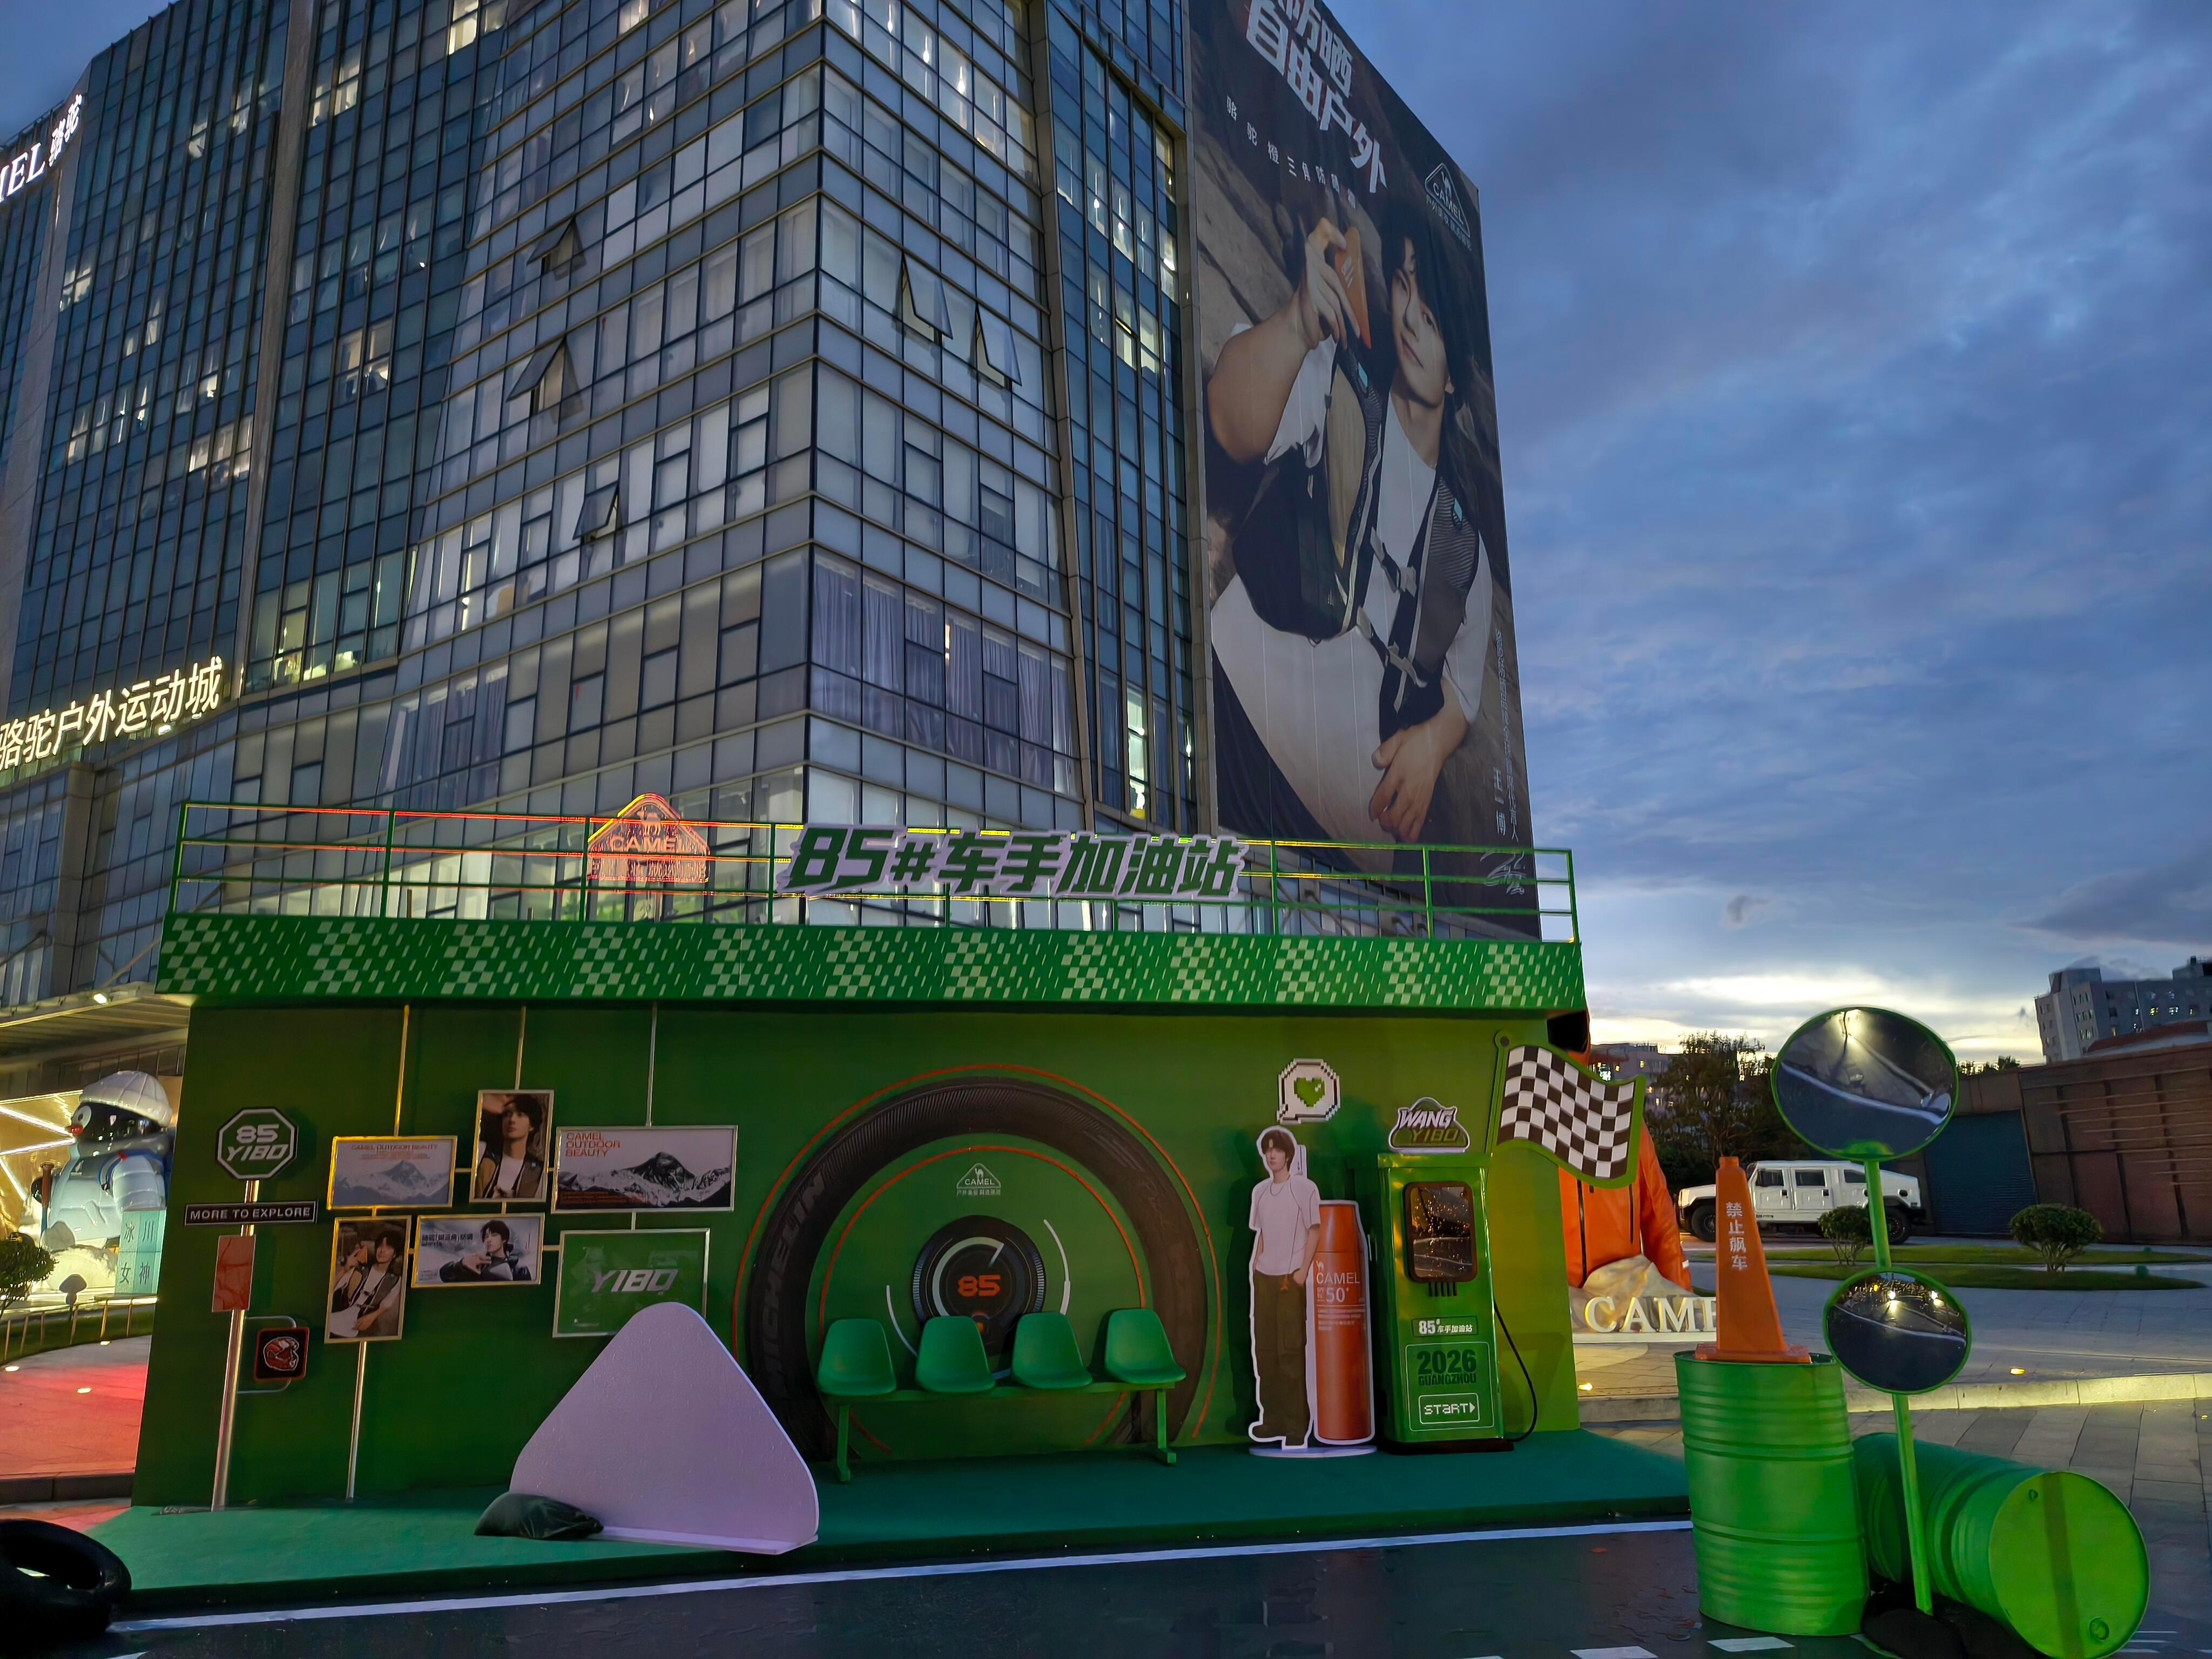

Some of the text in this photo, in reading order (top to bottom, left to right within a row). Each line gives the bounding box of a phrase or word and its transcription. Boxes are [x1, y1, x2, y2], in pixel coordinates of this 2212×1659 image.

[1246, 0, 1387, 193] 自由户外
[1433, 183, 1464, 225] CAMEL
[0, 656, 222, 771] 骆驼户外运动城
[610, 835, 686, 852] CAMEL
[786, 828, 1240, 896] 85#车手加油站
[1399, 1109, 1455, 1129] WANG
[236, 1124, 279, 1143] 85
[567, 1132, 602, 1140] CAMEL
[1412, 1129, 1459, 1142] YIBO
[227, 1144, 289, 1161] YIBO
[565, 1149, 609, 1157] BEAUTY
[566, 1140, 621, 1149] OUTDOOR
[190, 1208, 311, 1220] MORE TO EXPLORE
[124, 1221, 154, 1243] 冰川
[1726, 1202, 1748, 1271] 禁止飙车
[120, 1262, 150, 1284] 女神
[591, 1270, 679, 1292] YIBO
[1317, 1272, 1360, 1284] CAMEL
[958, 1275, 1001, 1297] 85
[1417, 1350, 1477, 1375] 2026
[1419, 1374, 1476, 1386] GUANGZHOU
